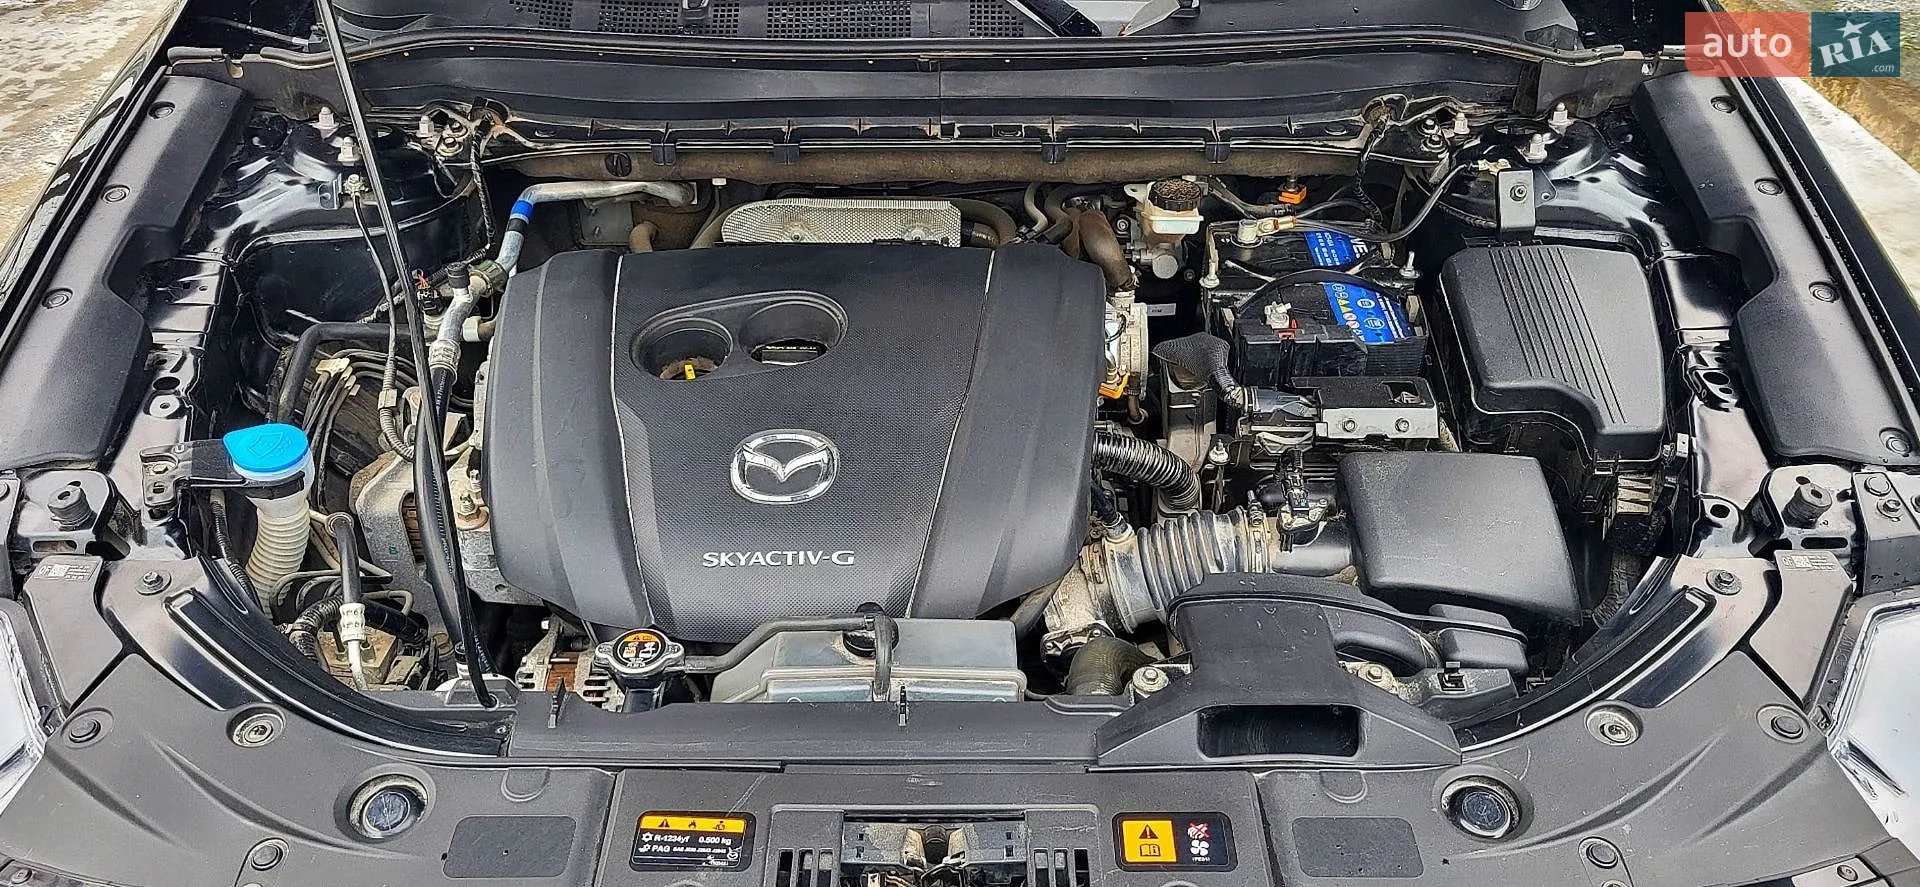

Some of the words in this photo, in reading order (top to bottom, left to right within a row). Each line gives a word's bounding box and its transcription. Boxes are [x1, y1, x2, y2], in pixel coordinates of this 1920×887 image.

[702, 550, 855, 567] SKYACTIV-G
[653, 834, 691, 844] R-1234yf
[698, 836, 720, 844] 0.500
[721, 837, 732, 846] kg
[651, 844, 671, 853] PAG
